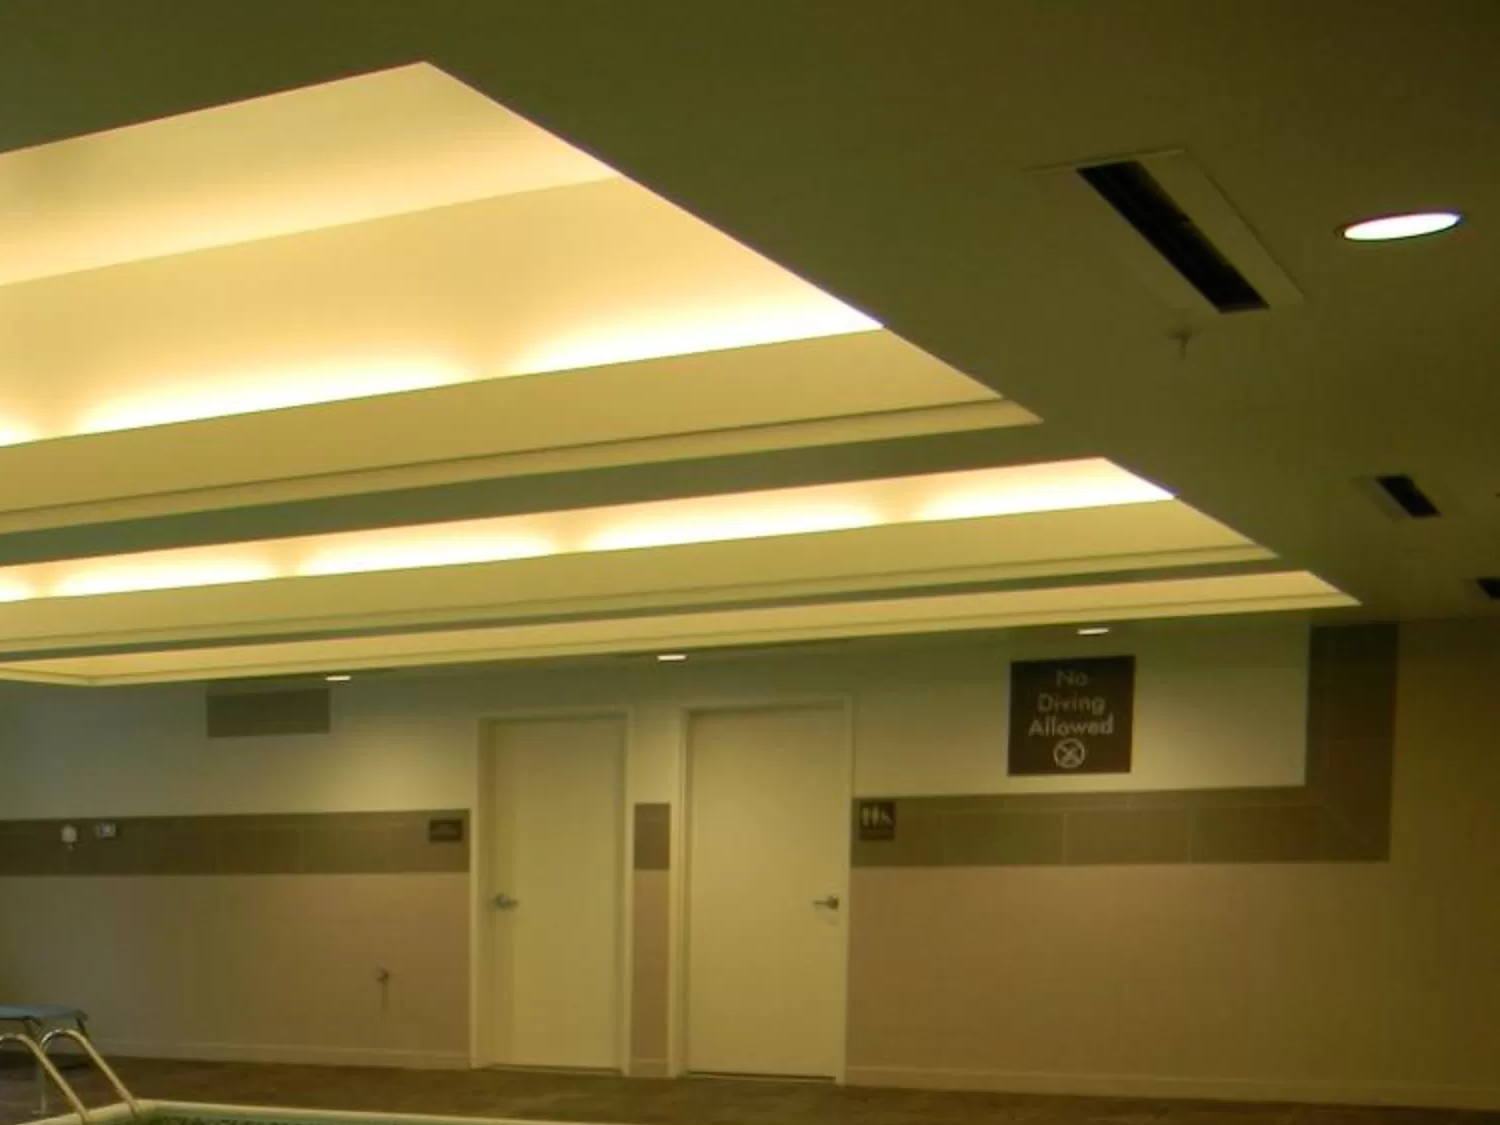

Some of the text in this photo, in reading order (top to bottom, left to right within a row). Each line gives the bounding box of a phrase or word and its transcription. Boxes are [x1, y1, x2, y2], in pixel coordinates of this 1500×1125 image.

[1055, 669, 1089, 688] No
[1037, 691, 1107, 717] Diving
[1028, 711, 1115, 737] Allowed
